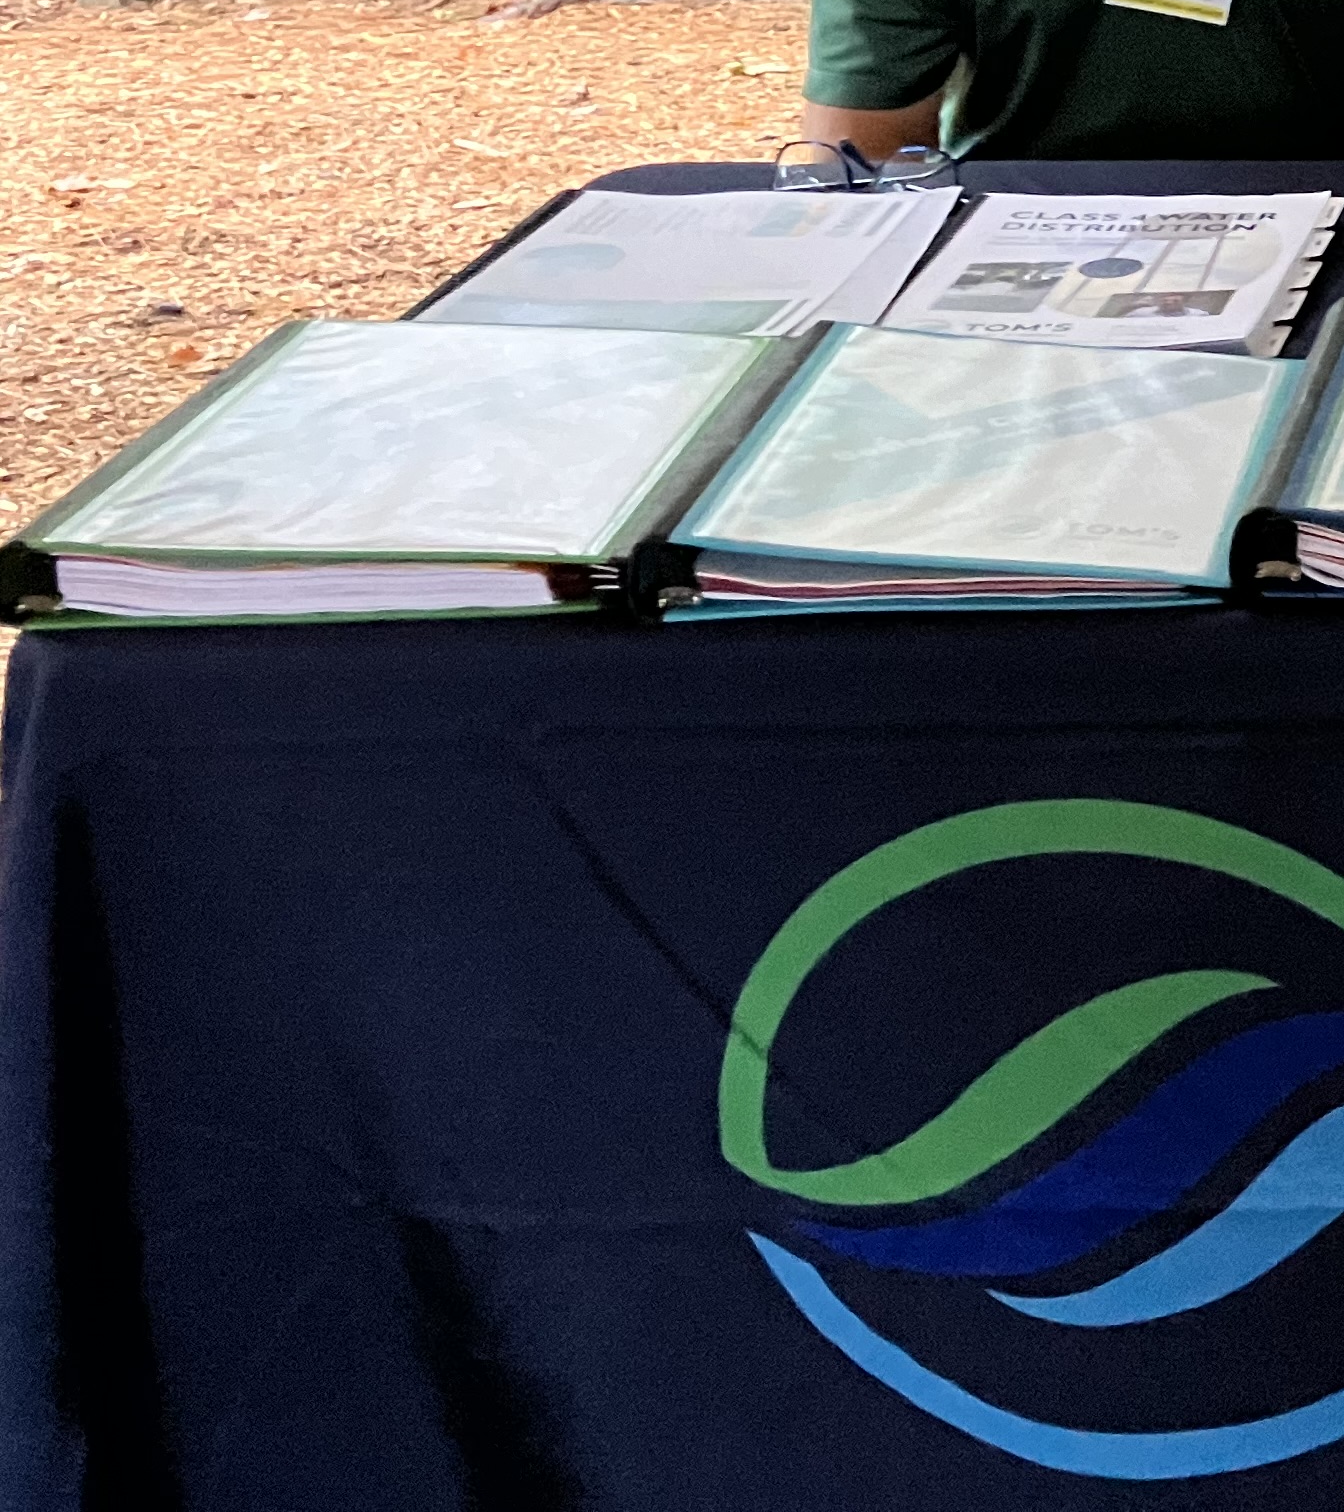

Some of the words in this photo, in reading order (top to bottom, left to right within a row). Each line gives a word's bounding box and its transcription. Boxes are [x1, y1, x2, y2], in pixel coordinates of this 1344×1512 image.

[1010, 211, 1120, 221] CLASS
[1151, 212, 1278, 221] WATER
[1000, 221, 1259, 233] DISTRIBUTION
[965, 322, 1072, 333] TOM'S
